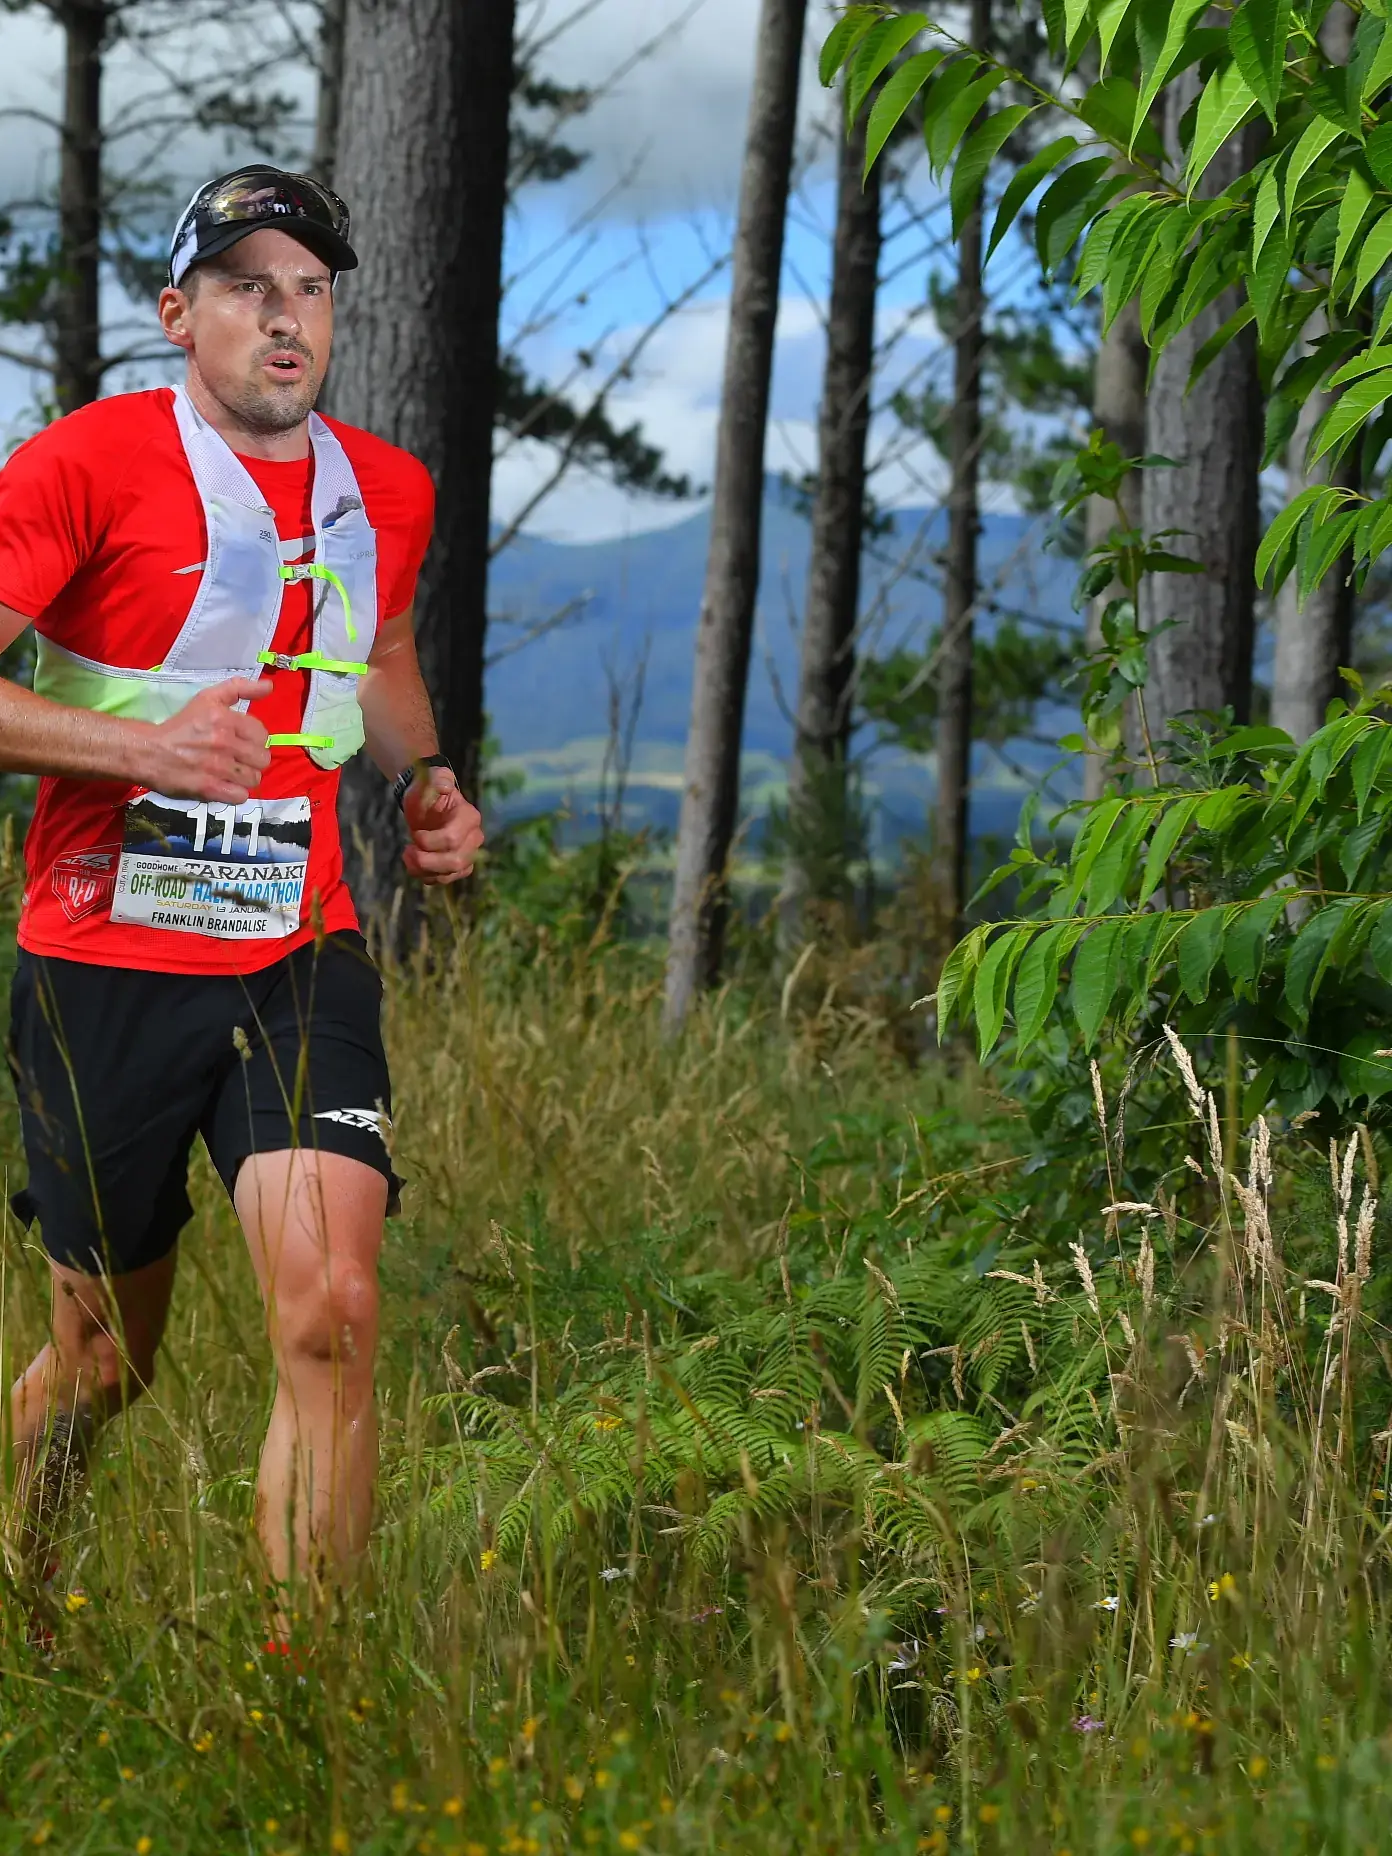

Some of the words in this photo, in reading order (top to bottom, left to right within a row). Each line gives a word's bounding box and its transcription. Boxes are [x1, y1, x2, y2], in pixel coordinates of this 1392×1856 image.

[187, 802, 263, 857] 111
[57, 858, 111, 871] ALTRA
[136, 861, 179, 872] GOODHOME
[185, 862, 305, 881] TARANAKI
[130, 873, 187, 900] OFF-ROAD
[193, 880, 230, 904] HALF
[232, 881, 302, 904] MARATHON
[156, 899, 213, 911] SATURDAY
[151, 911, 204, 928] FRANKLIN
[207, 917, 268, 932] BRANDALISE
